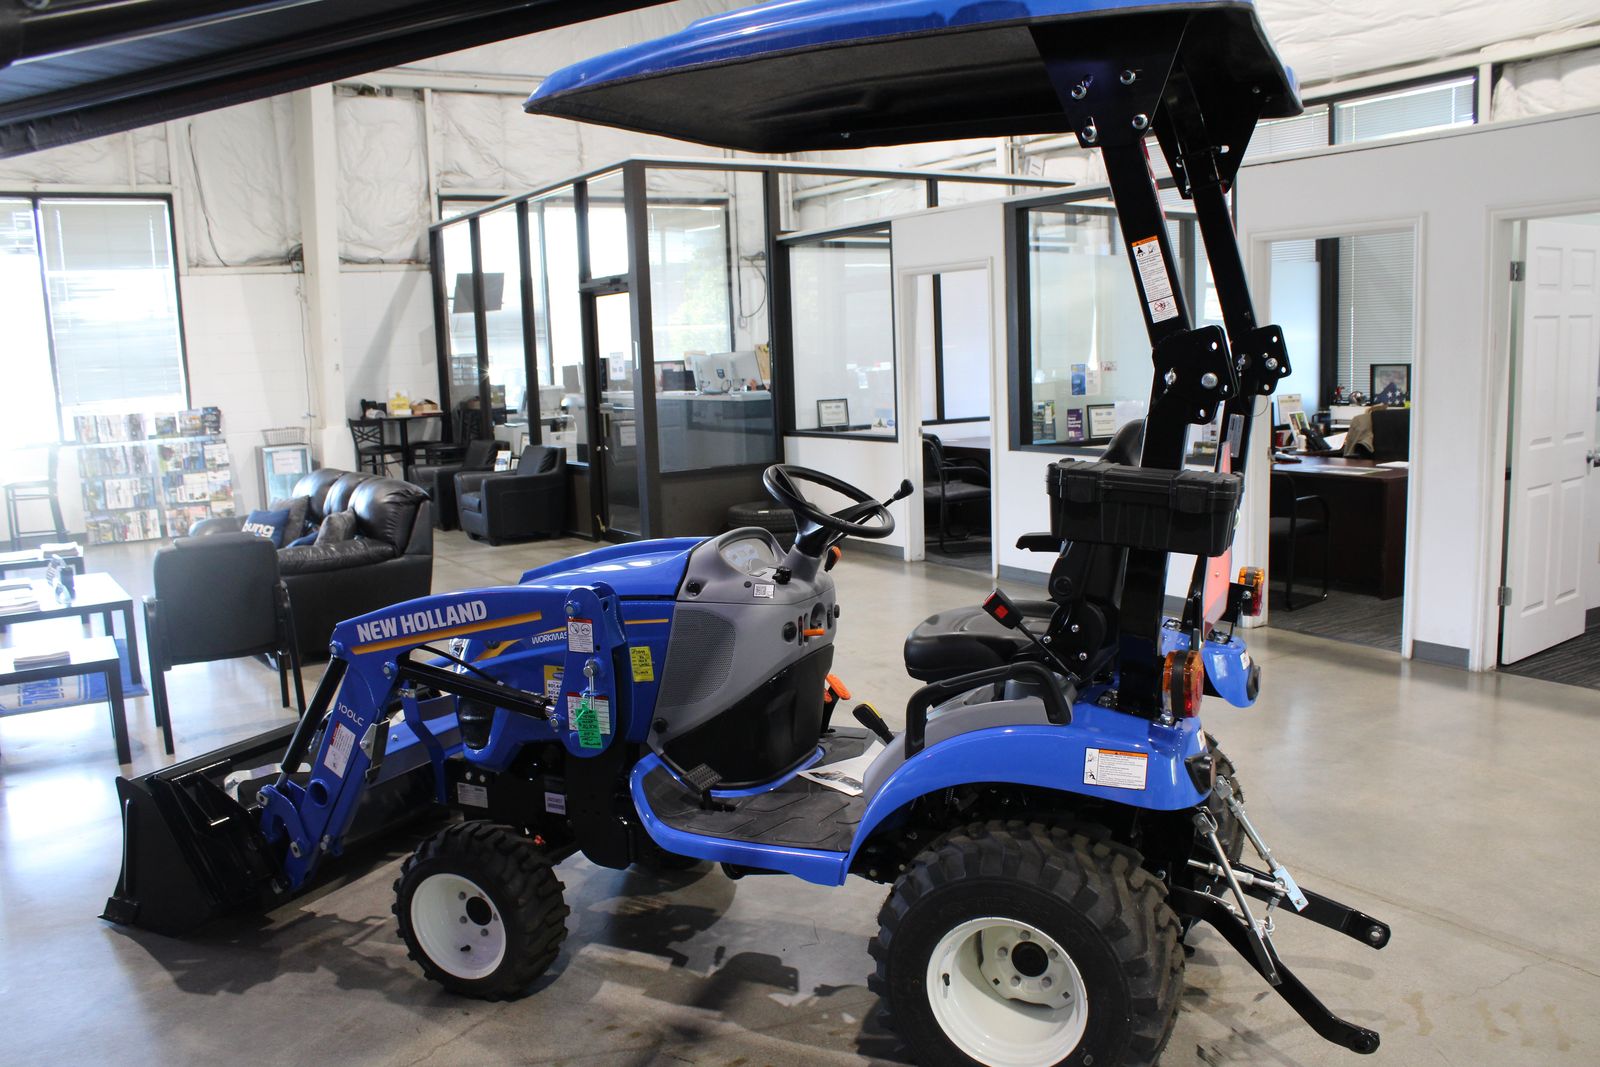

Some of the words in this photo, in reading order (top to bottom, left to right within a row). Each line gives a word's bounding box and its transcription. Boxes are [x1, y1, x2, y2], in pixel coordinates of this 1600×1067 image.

[356, 617, 398, 643] NEW
[400, 600, 487, 635] HOLLAND
[338, 702, 365, 727] 100LC
